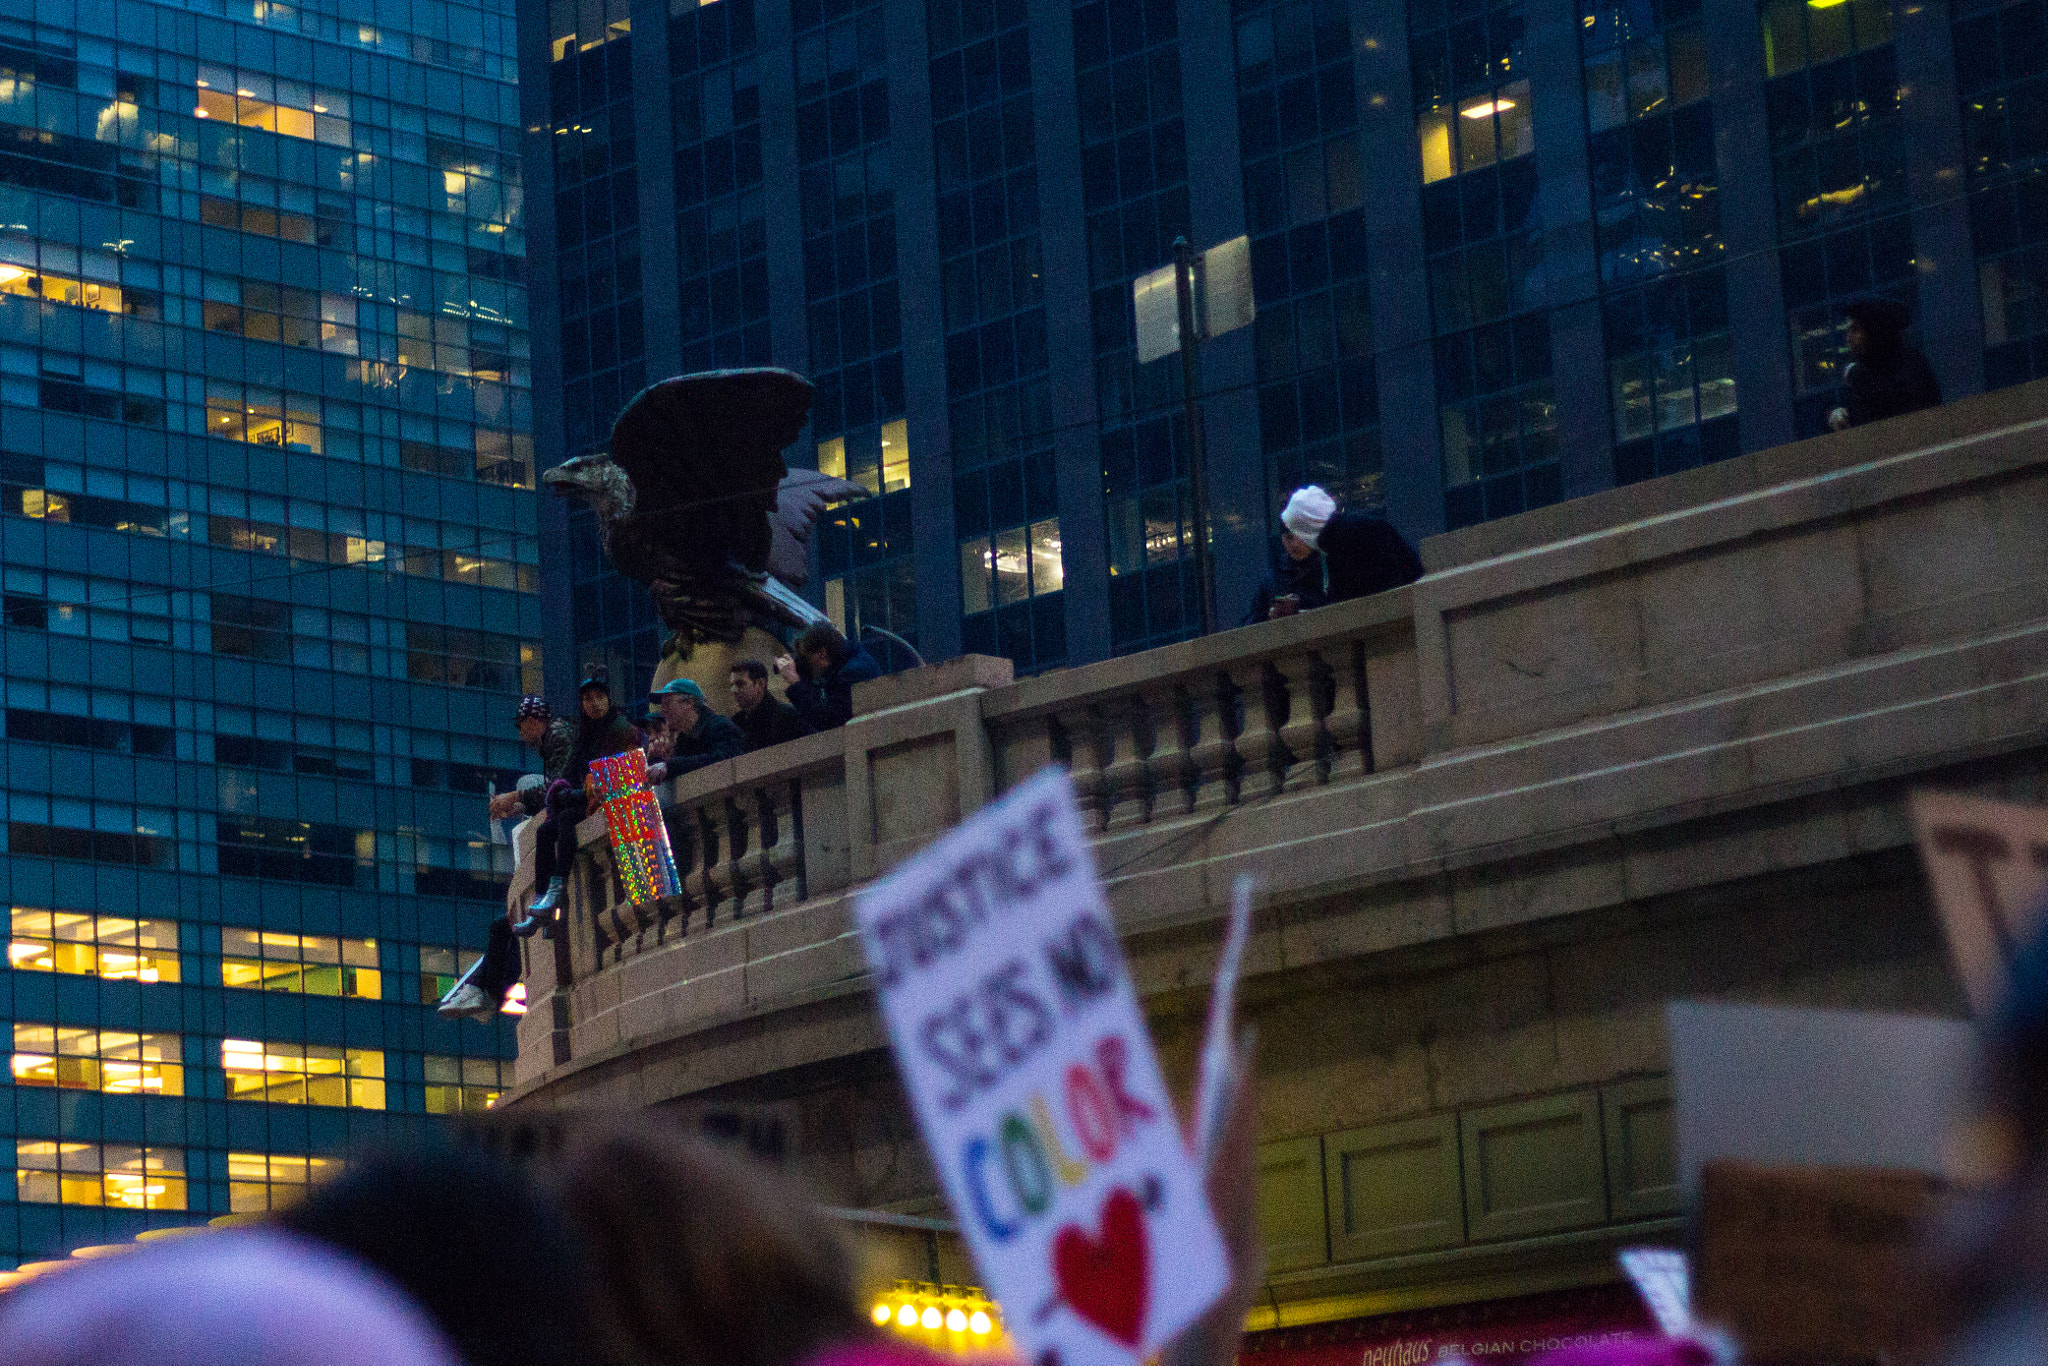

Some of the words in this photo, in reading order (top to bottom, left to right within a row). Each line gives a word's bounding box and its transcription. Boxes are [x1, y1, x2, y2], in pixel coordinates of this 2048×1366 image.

[874, 800, 1076, 990] JUSTICE
[918, 955, 1055, 1113] SEES
[961, 1033, 1158, 1243] COLOR
[1438, 1341, 1516, 1358] BELGIAN
[1519, 1331, 1634, 1353] CHOCOLATE
